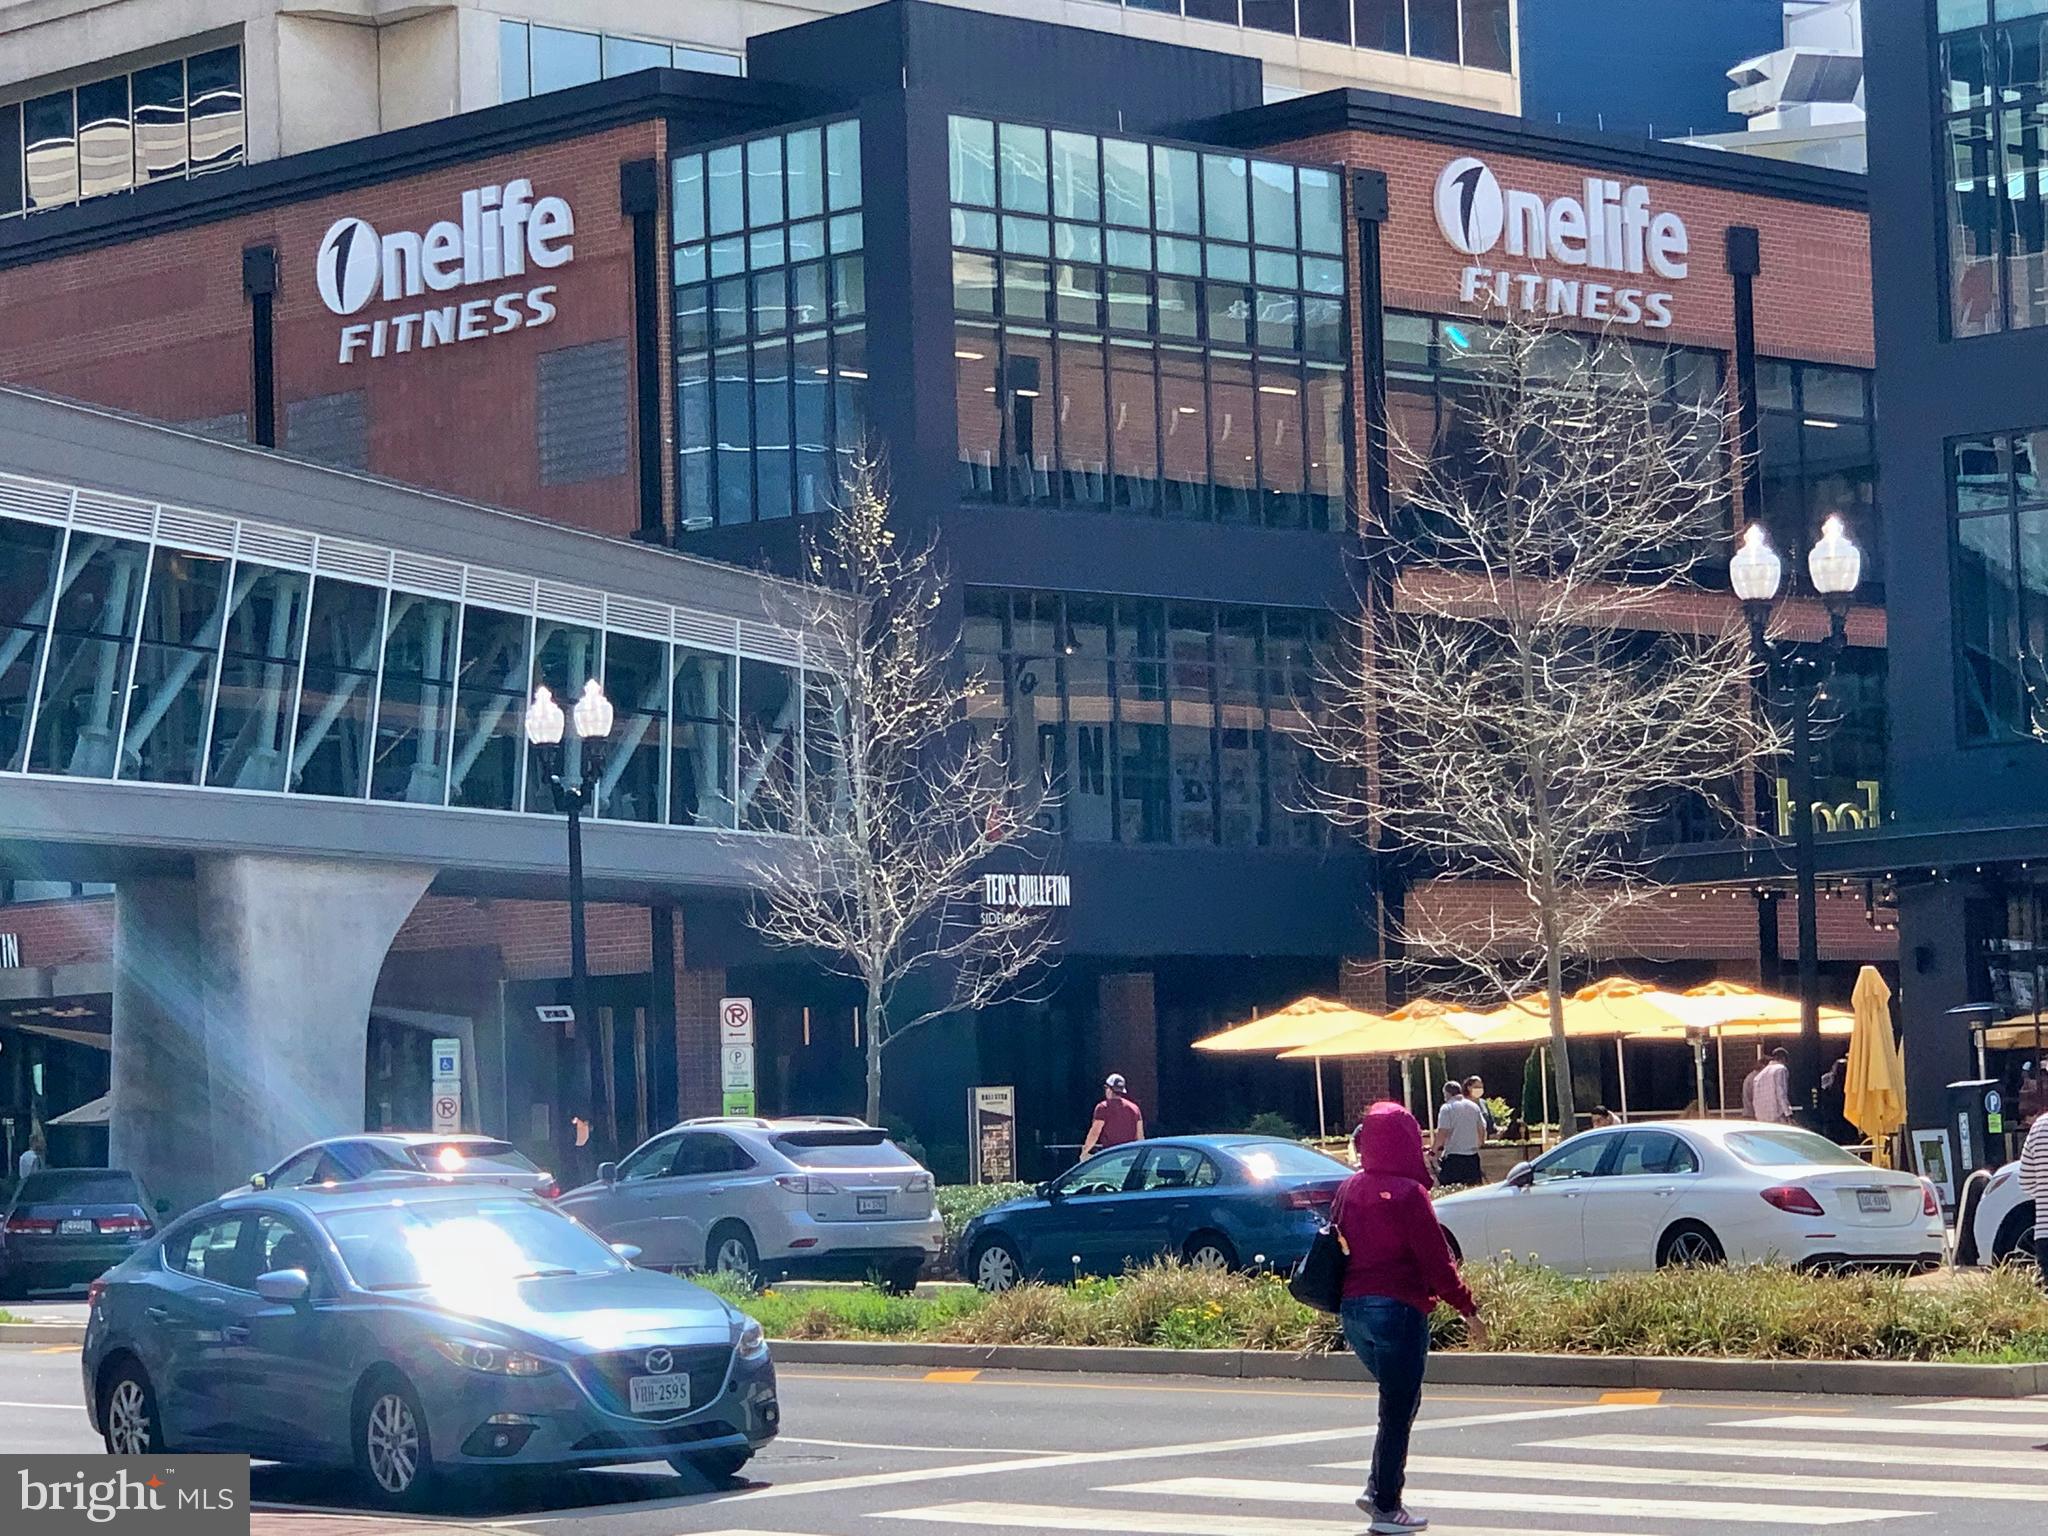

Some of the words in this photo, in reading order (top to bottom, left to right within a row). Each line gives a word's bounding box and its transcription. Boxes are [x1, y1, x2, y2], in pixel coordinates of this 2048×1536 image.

[316, 178, 575, 315] Onelife
[1433, 156, 1689, 280] Onelife
[338, 285, 558, 364] FITNESS
[1460, 266, 1674, 329] FITNESS
[984, 874, 1016, 906] TED'S
[1018, 874, 1071, 907] BULLETIN
[0, 932, 20, 969] IN
